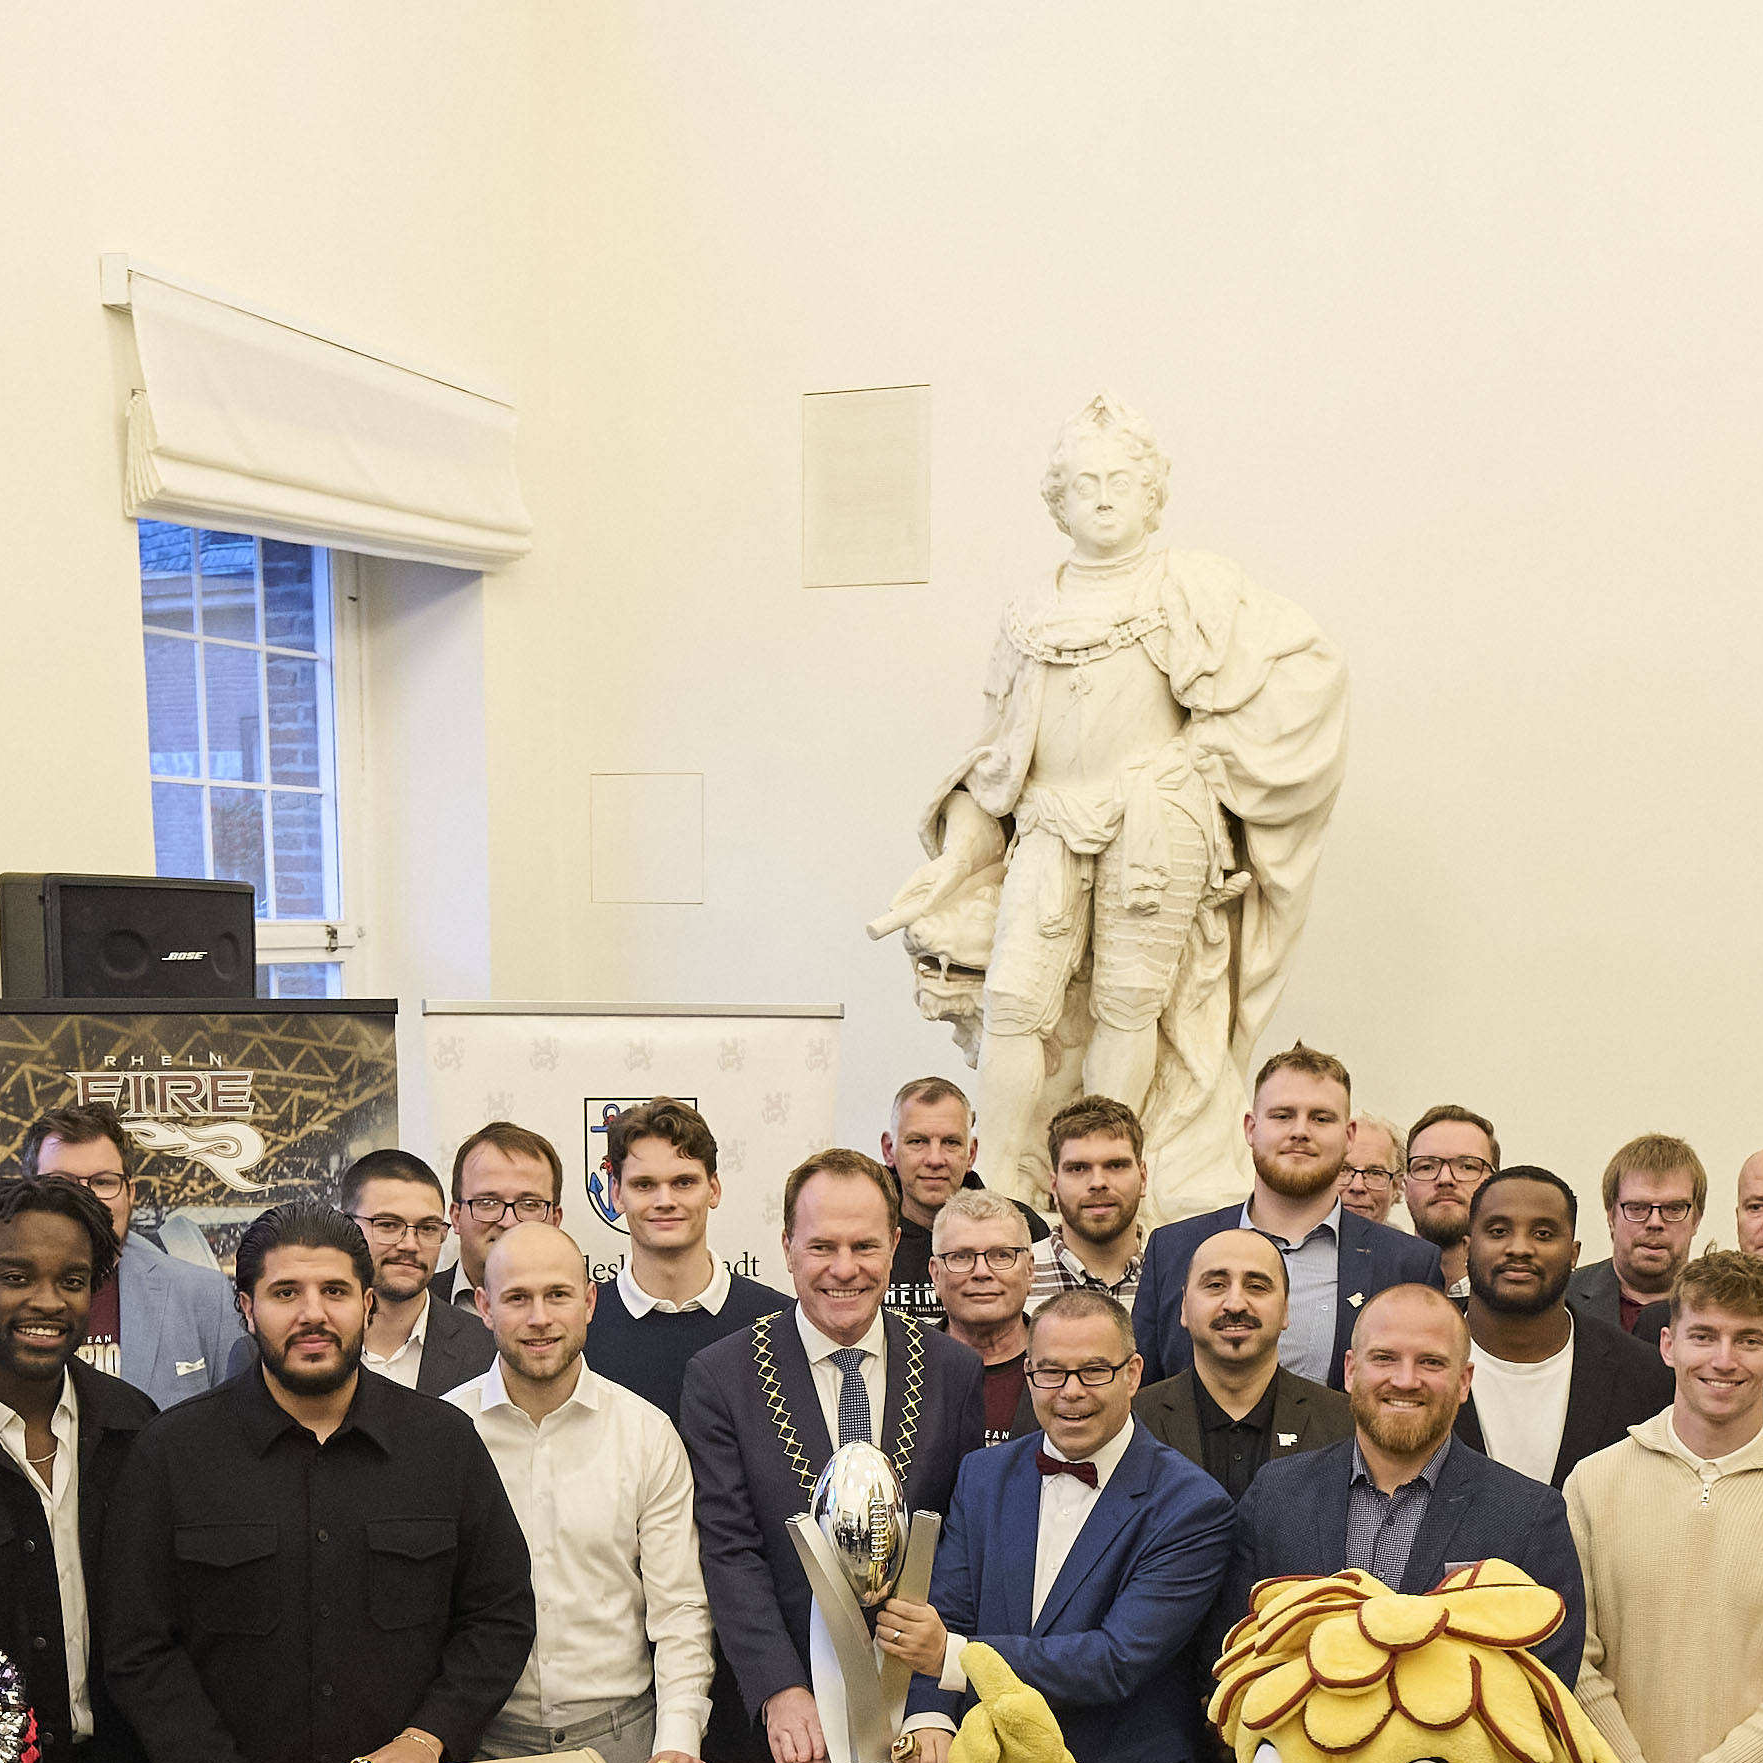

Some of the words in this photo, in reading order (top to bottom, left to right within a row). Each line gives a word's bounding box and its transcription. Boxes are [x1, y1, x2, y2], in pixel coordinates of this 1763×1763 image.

[161, 951, 208, 961] BOSE
[103, 1052, 223, 1068] RHEIN
[66, 1071, 255, 1118] FIRE
